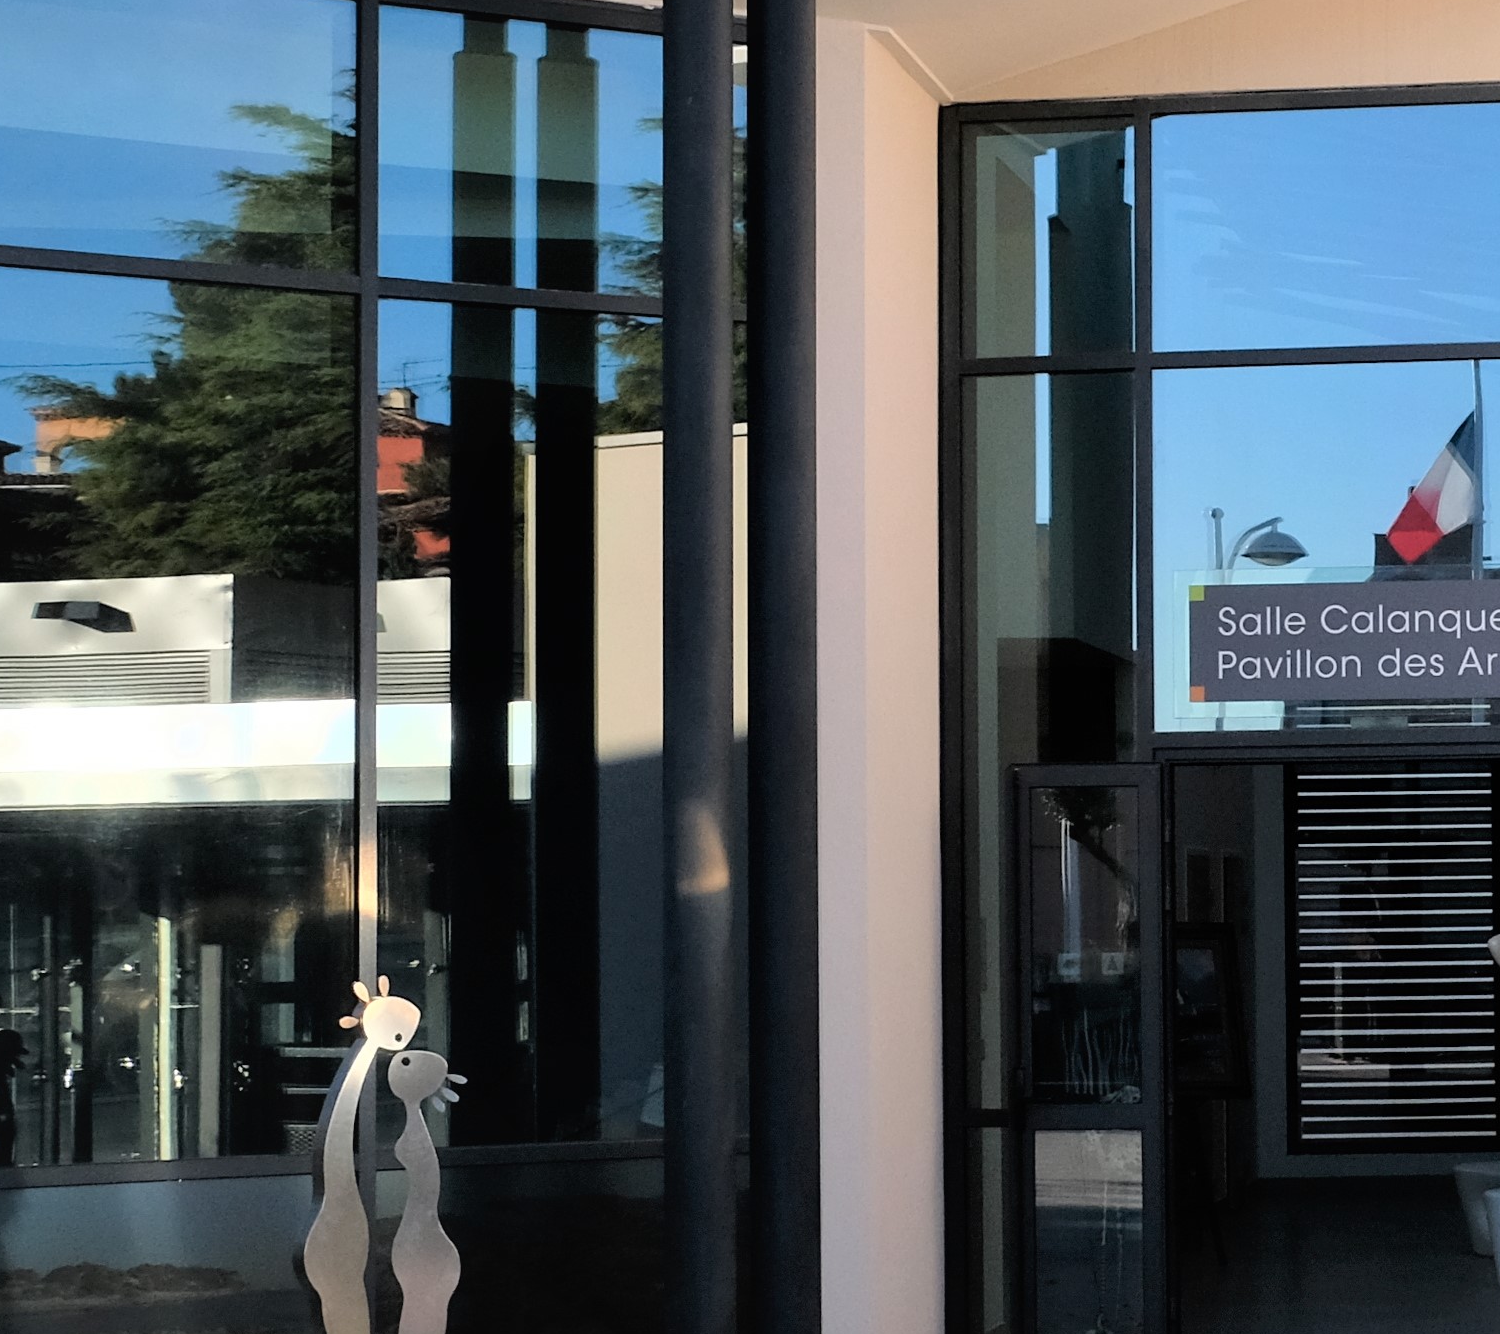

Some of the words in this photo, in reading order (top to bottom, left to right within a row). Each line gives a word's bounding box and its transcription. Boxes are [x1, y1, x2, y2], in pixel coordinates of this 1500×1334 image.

[1217, 606, 1307, 636] Salle
[1217, 648, 1362, 680] Pavillon
[1377, 647, 1445, 678] des
